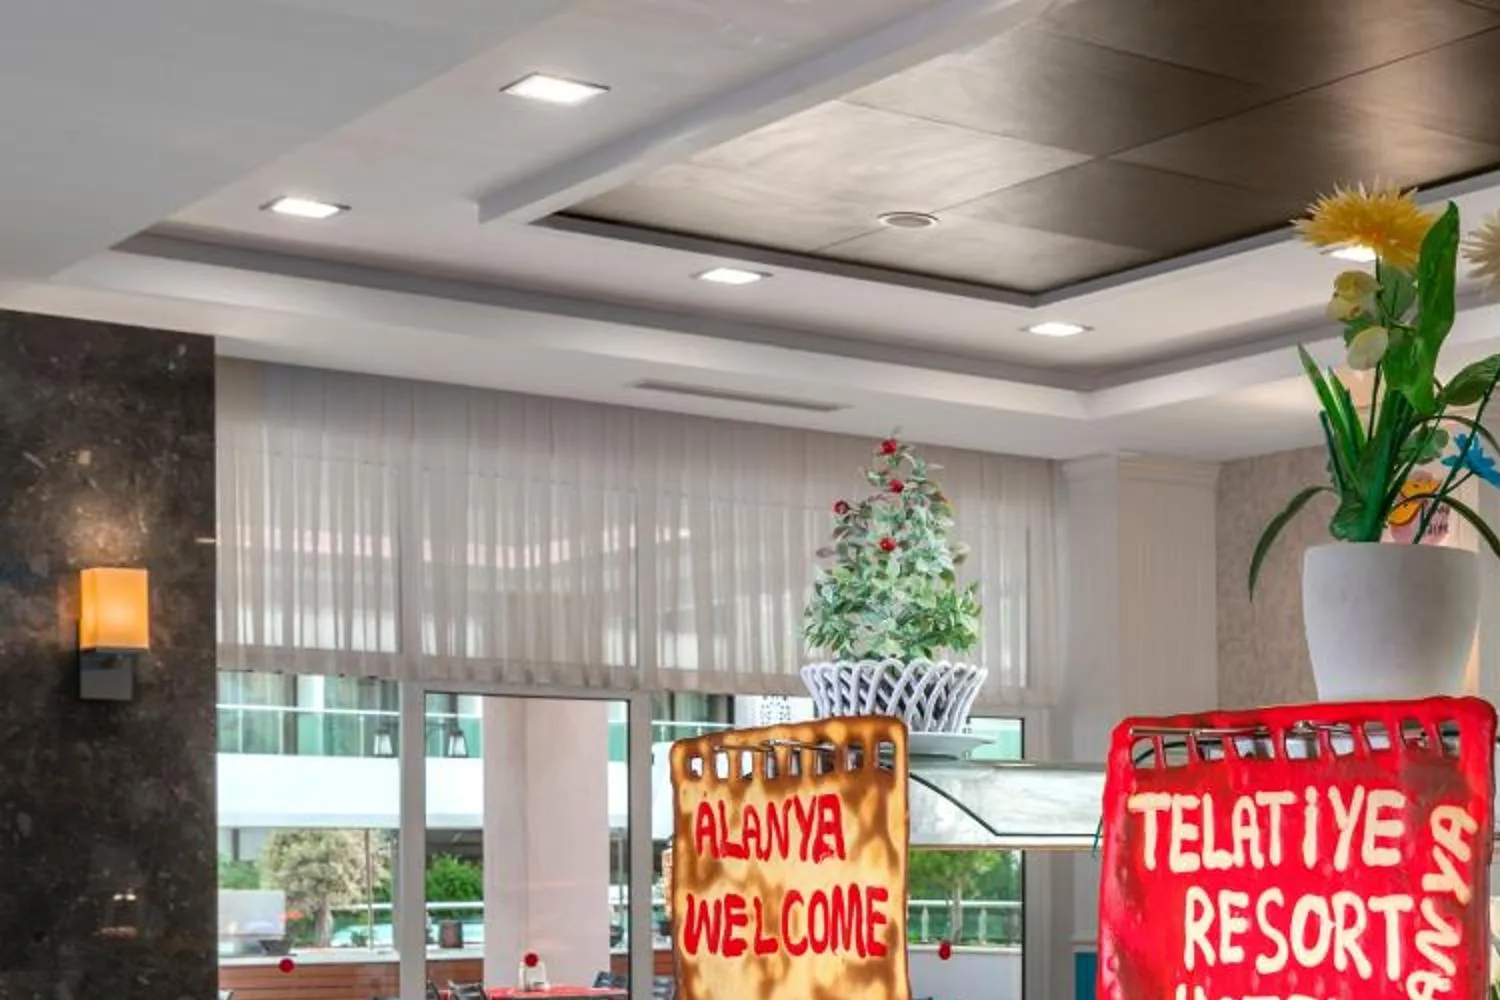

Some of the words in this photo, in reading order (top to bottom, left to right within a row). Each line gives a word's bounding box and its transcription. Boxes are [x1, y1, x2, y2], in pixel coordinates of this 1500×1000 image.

[693, 793, 848, 864] ALANYA
[682, 883, 891, 958] WELCOME
[1183, 885, 1414, 982] RESORT
